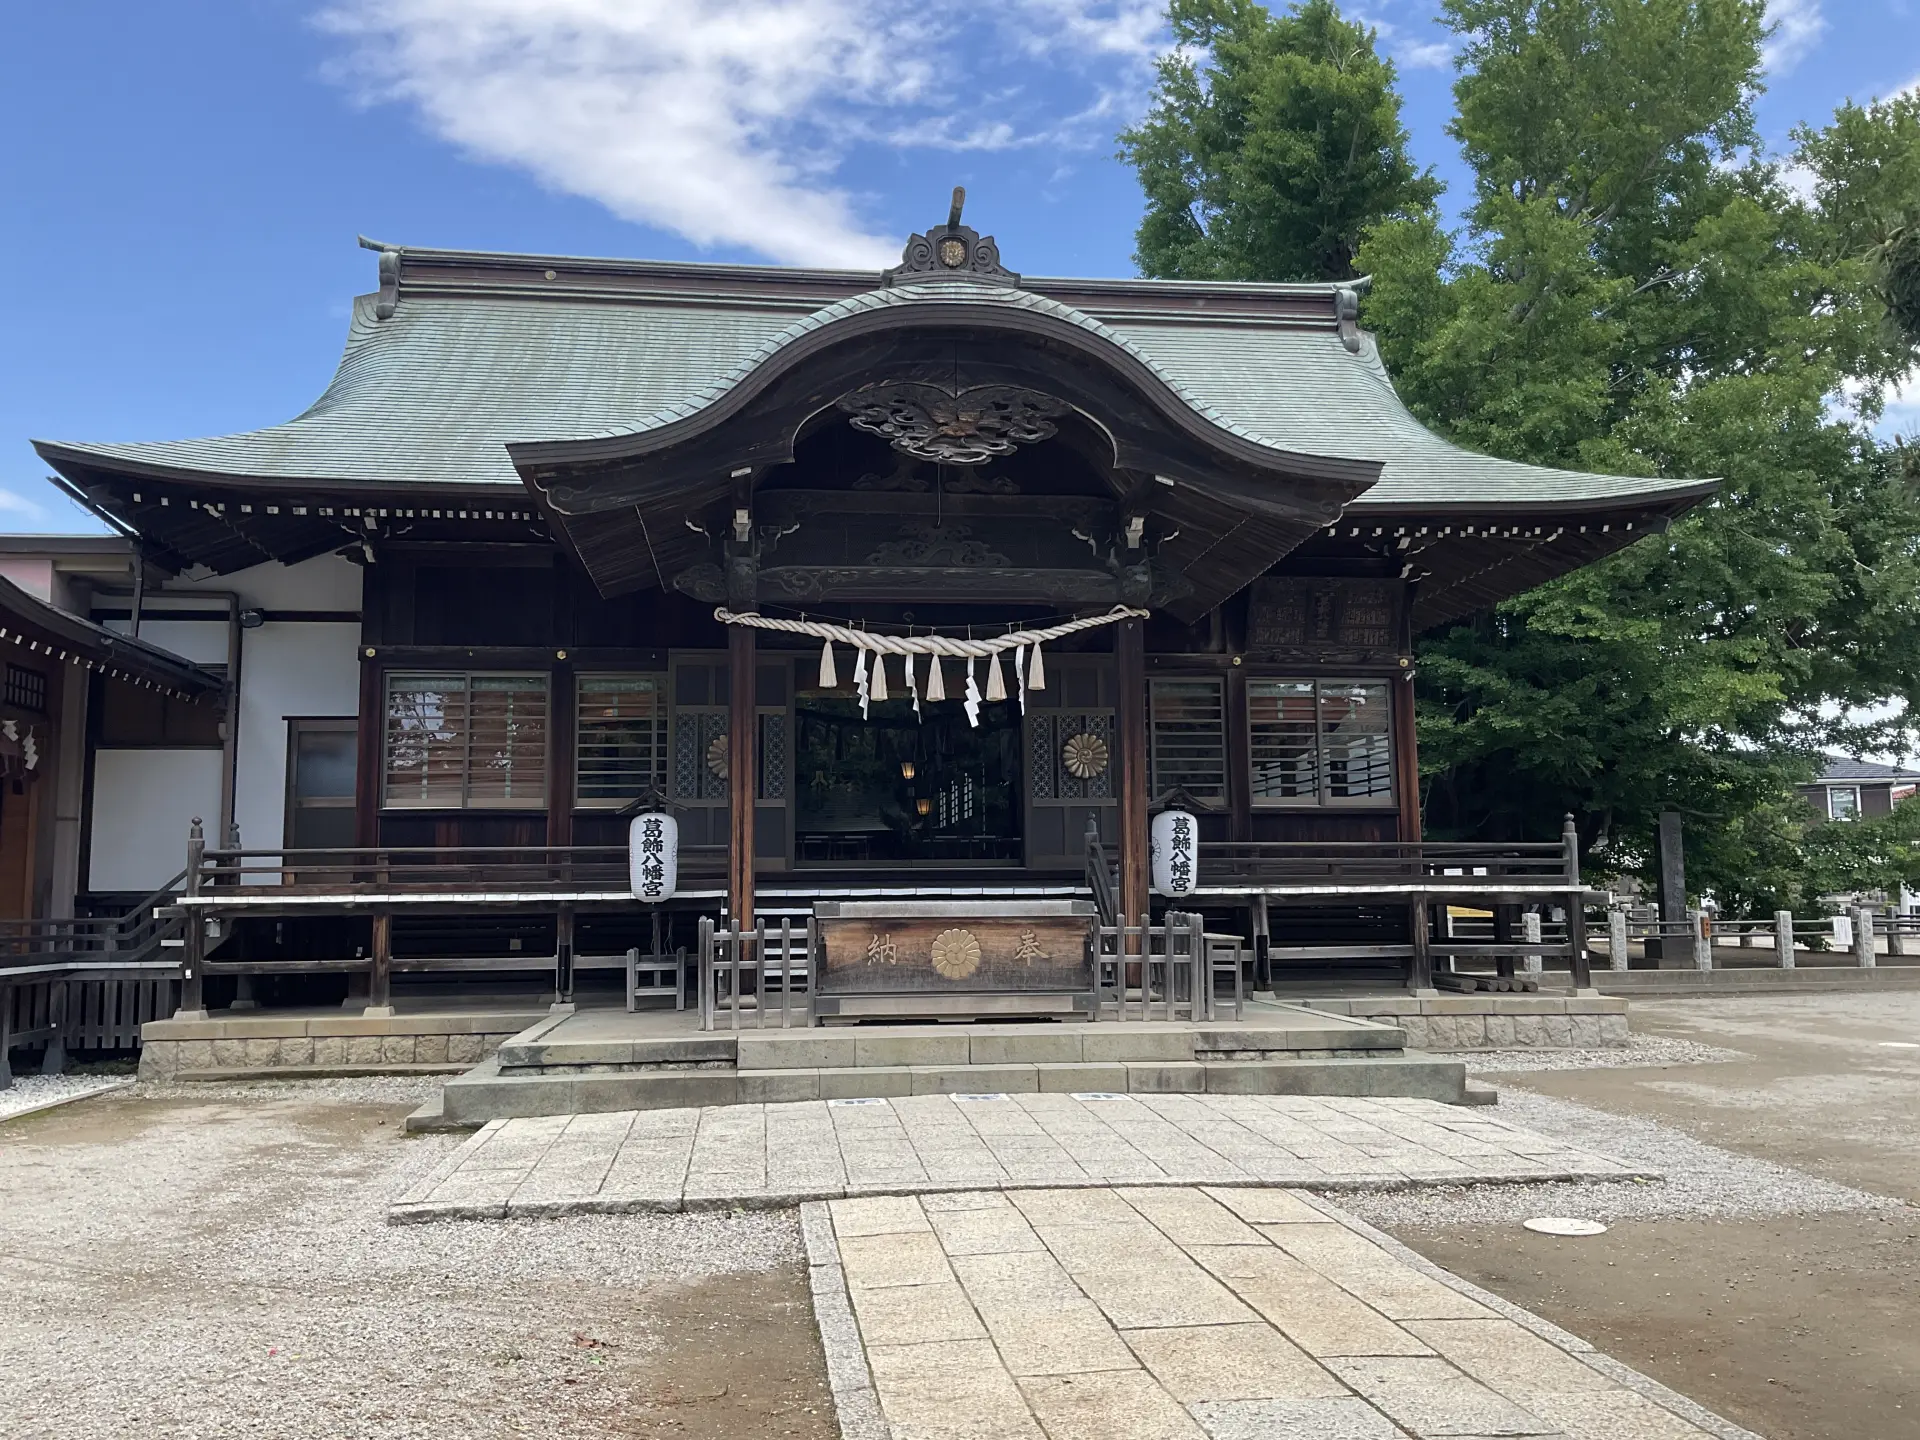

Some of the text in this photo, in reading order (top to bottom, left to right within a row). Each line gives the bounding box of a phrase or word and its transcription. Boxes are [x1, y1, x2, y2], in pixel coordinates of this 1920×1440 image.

[641, 818, 664, 897] 葛飾八幡宮
[1169, 816, 1191, 893] 葛飾八幡宮
[866, 929, 1050, 967] 奉 納
